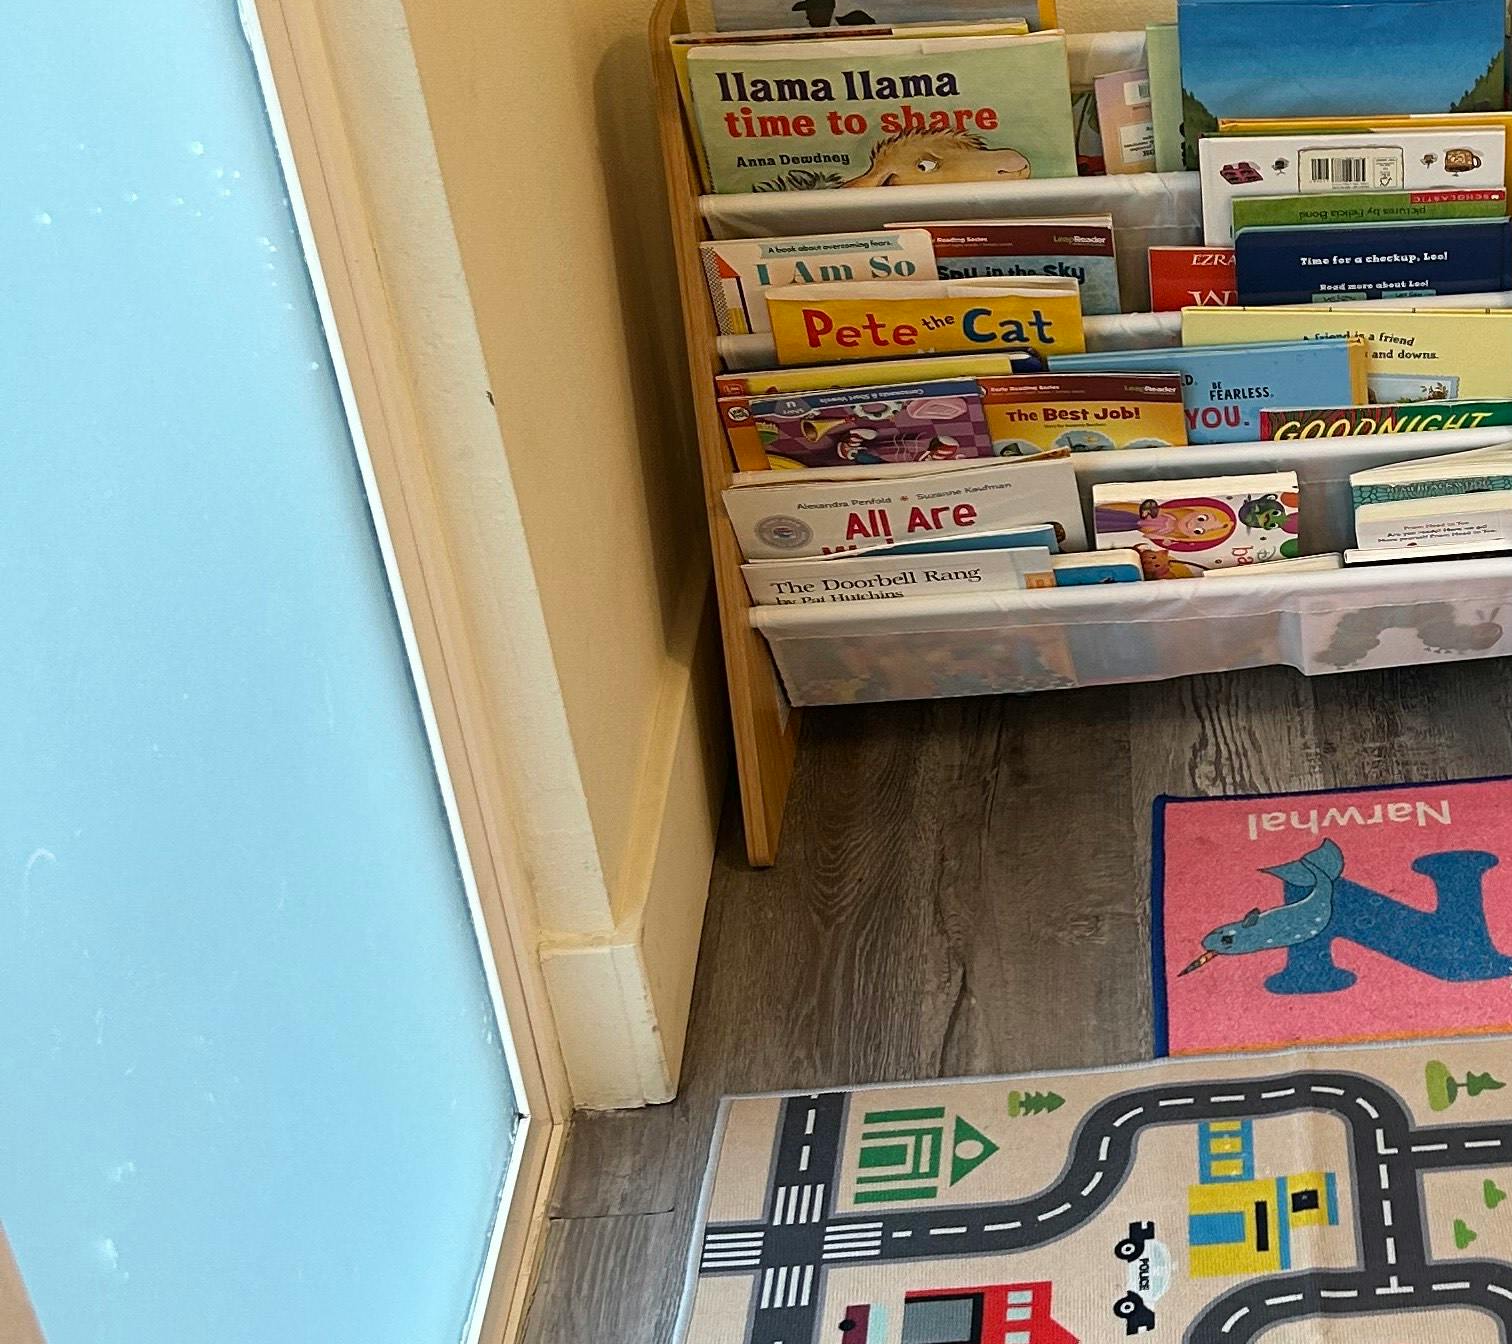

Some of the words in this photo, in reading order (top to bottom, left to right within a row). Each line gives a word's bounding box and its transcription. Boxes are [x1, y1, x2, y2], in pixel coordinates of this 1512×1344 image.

[715, 71, 835, 103] llama
[841, 69, 960, 101] llama
[723, 107, 817, 139] time
[826, 109, 868, 136] to
[879, 104, 1000, 134] share
[736, 153, 777, 168] Anna
[778, 151, 850, 168] Dewdney
[1367, 207, 1381, 218] by
[775, 244, 798, 254] book
[798, 243, 823, 252] about
[823, 240, 870, 251] overcoming
[757, 263, 772, 286] I
[789, 260, 854, 284] Am
[868, 255, 916, 279] So
[1300, 256, 1330, 267] Time
[1332, 255, 1351, 265] for
[1354, 256, 1363, 264] a
[1007, 263, 1037, 277] the
[1042, 261, 1086, 285] Sky
[1319, 282, 1346, 292] Read
[1347, 282, 1374, 291] more
[1375, 280, 1407, 290] about
[802, 308, 919, 348] Pete
[921, 313, 956, 333] the
[962, 309, 1055, 345] Cat
[1368, 333, 1376, 341] a
[1378, 332, 1415, 347] friend
[1371, 348, 1394, 359] and
[1397, 348, 1439, 360] downs.
[1209, 387, 1274, 401] FEARLESS.
[1211, 382, 1223, 390] BE
[1005, 410, 1039, 423] The
[1042, 407, 1090, 423] Best
[1093, 406, 1141, 421] Job!
[1274, 411, 1495, 442] GOODNIGHT
[797, 499, 850, 511] Alexandra
[851, 496, 893, 506] Penfold
[915, 489, 962, 501] Suzanne
[845, 509, 893, 541] All
[907, 502, 979, 534] Are
[770, 581, 816, 595] The
[821, 571, 917, 592] Doorbell
[923, 566, 982, 584] Rang
[800, 594, 827, 605] Pat
[830, 589, 904, 603] Hutchins
[1247, 799, 1450, 842] Narwhal
[1138, 1258, 1150, 1292] POLICE
